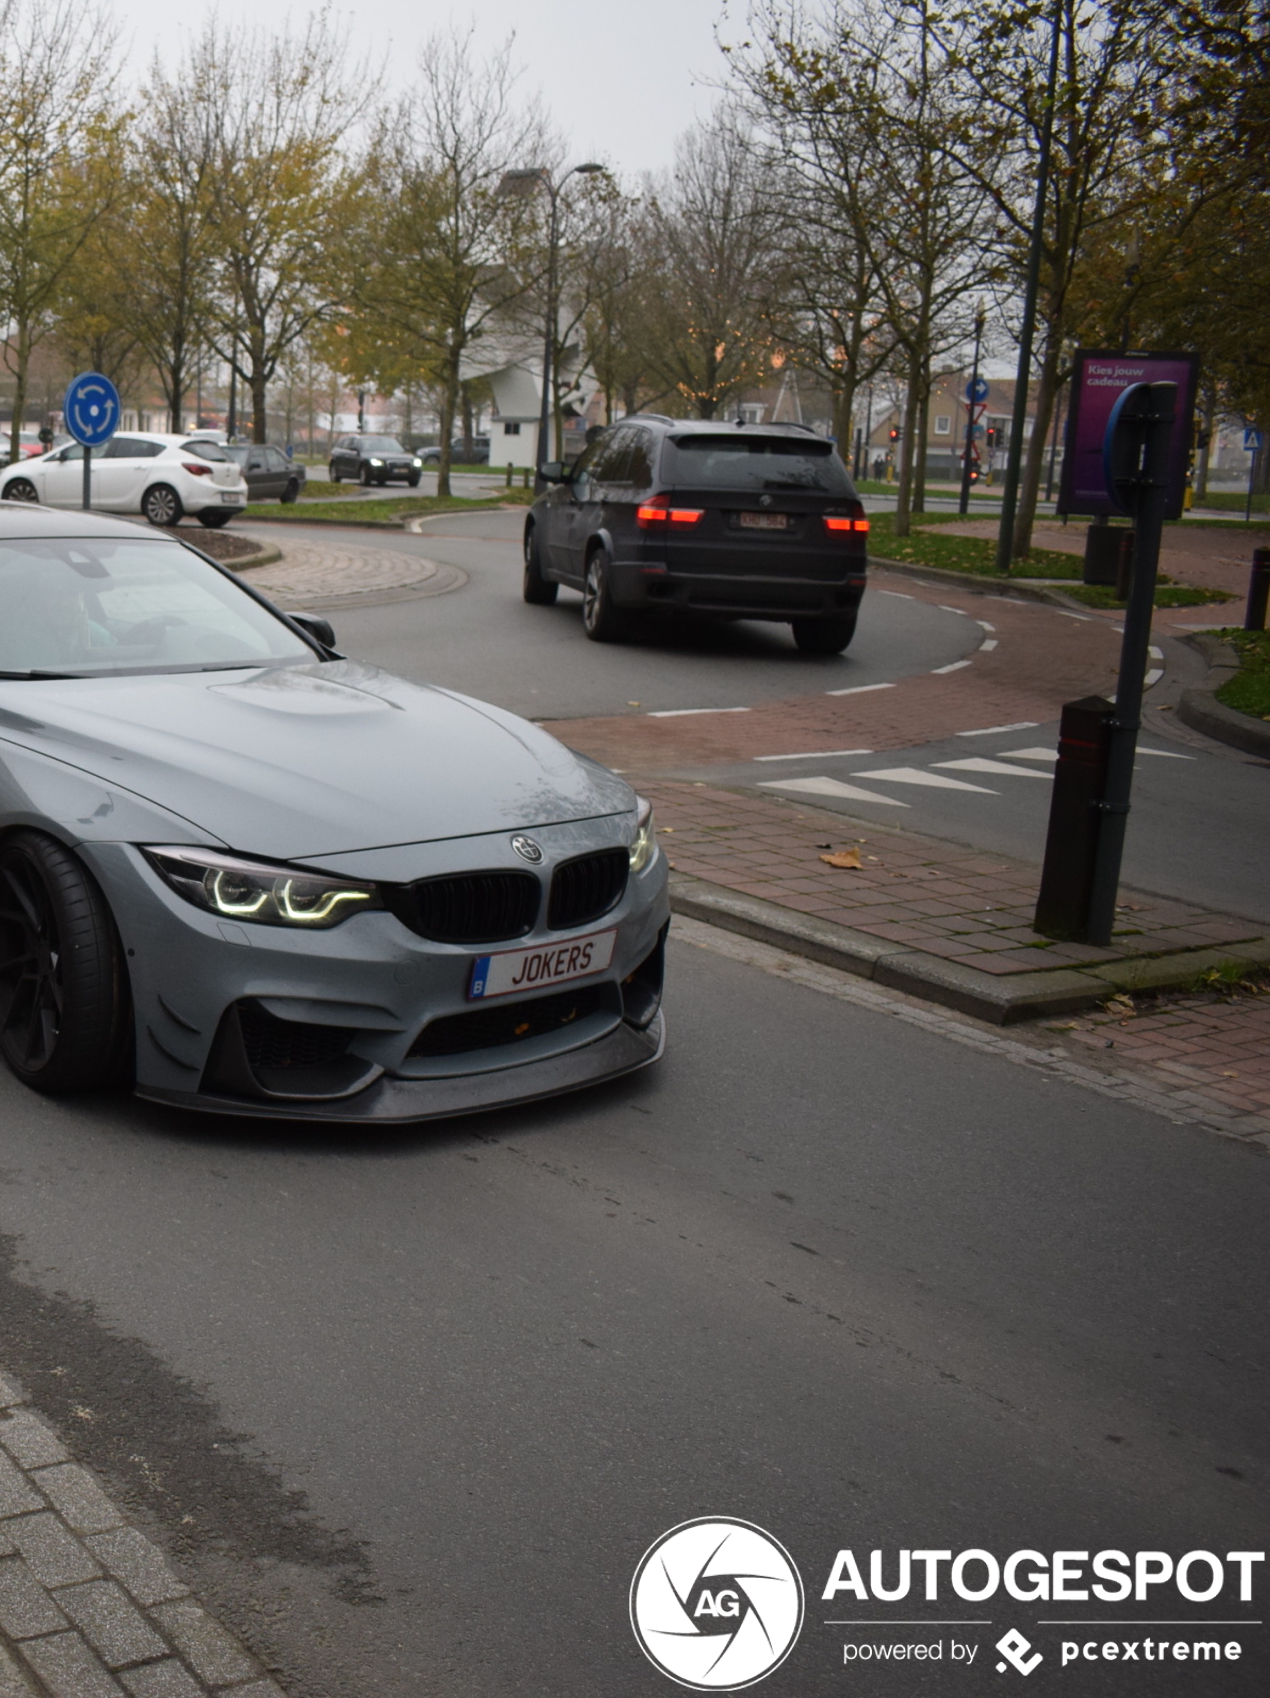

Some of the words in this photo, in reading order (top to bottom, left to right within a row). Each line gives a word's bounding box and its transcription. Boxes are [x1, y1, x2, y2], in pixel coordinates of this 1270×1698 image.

[1088, 364, 1113, 376] Kies
[1113, 365, 1144, 378] jouw
[1087, 376, 1129, 387] cadeau
[511, 942, 595, 985] JOKERS
[473, 980, 484, 994] B
